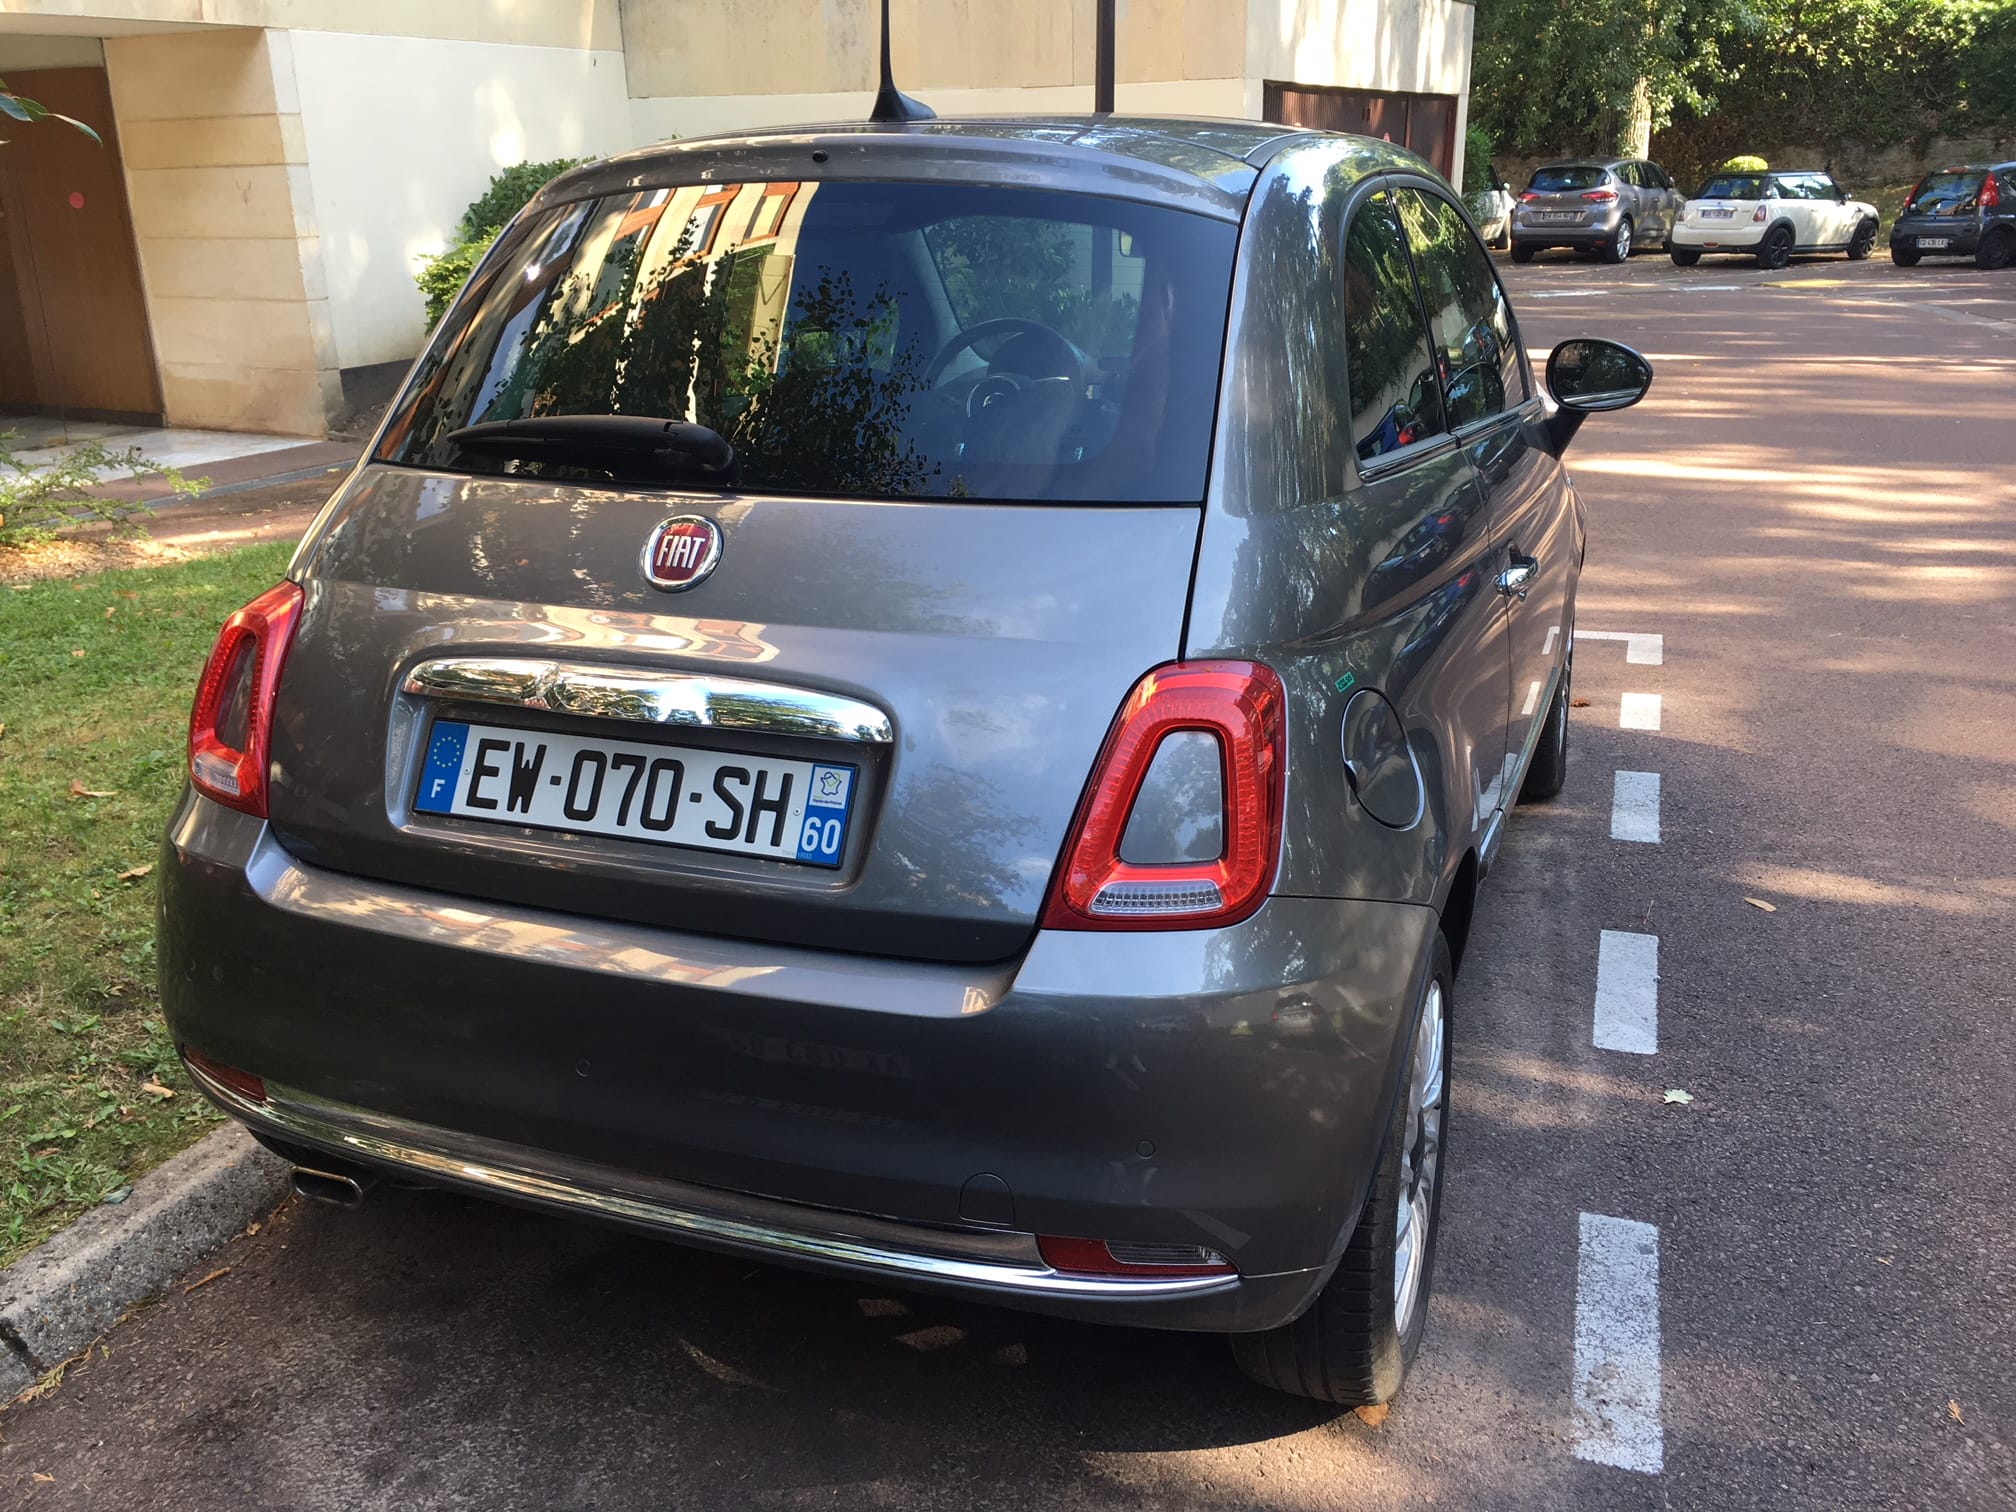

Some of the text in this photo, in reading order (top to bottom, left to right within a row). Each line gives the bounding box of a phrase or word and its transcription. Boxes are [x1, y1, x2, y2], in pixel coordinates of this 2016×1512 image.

[656, 535, 706, 569] FIAT
[431, 779, 446, 798] F
[466, 737, 794, 847] EW-070-SH
[801, 816, 842, 855] 60
